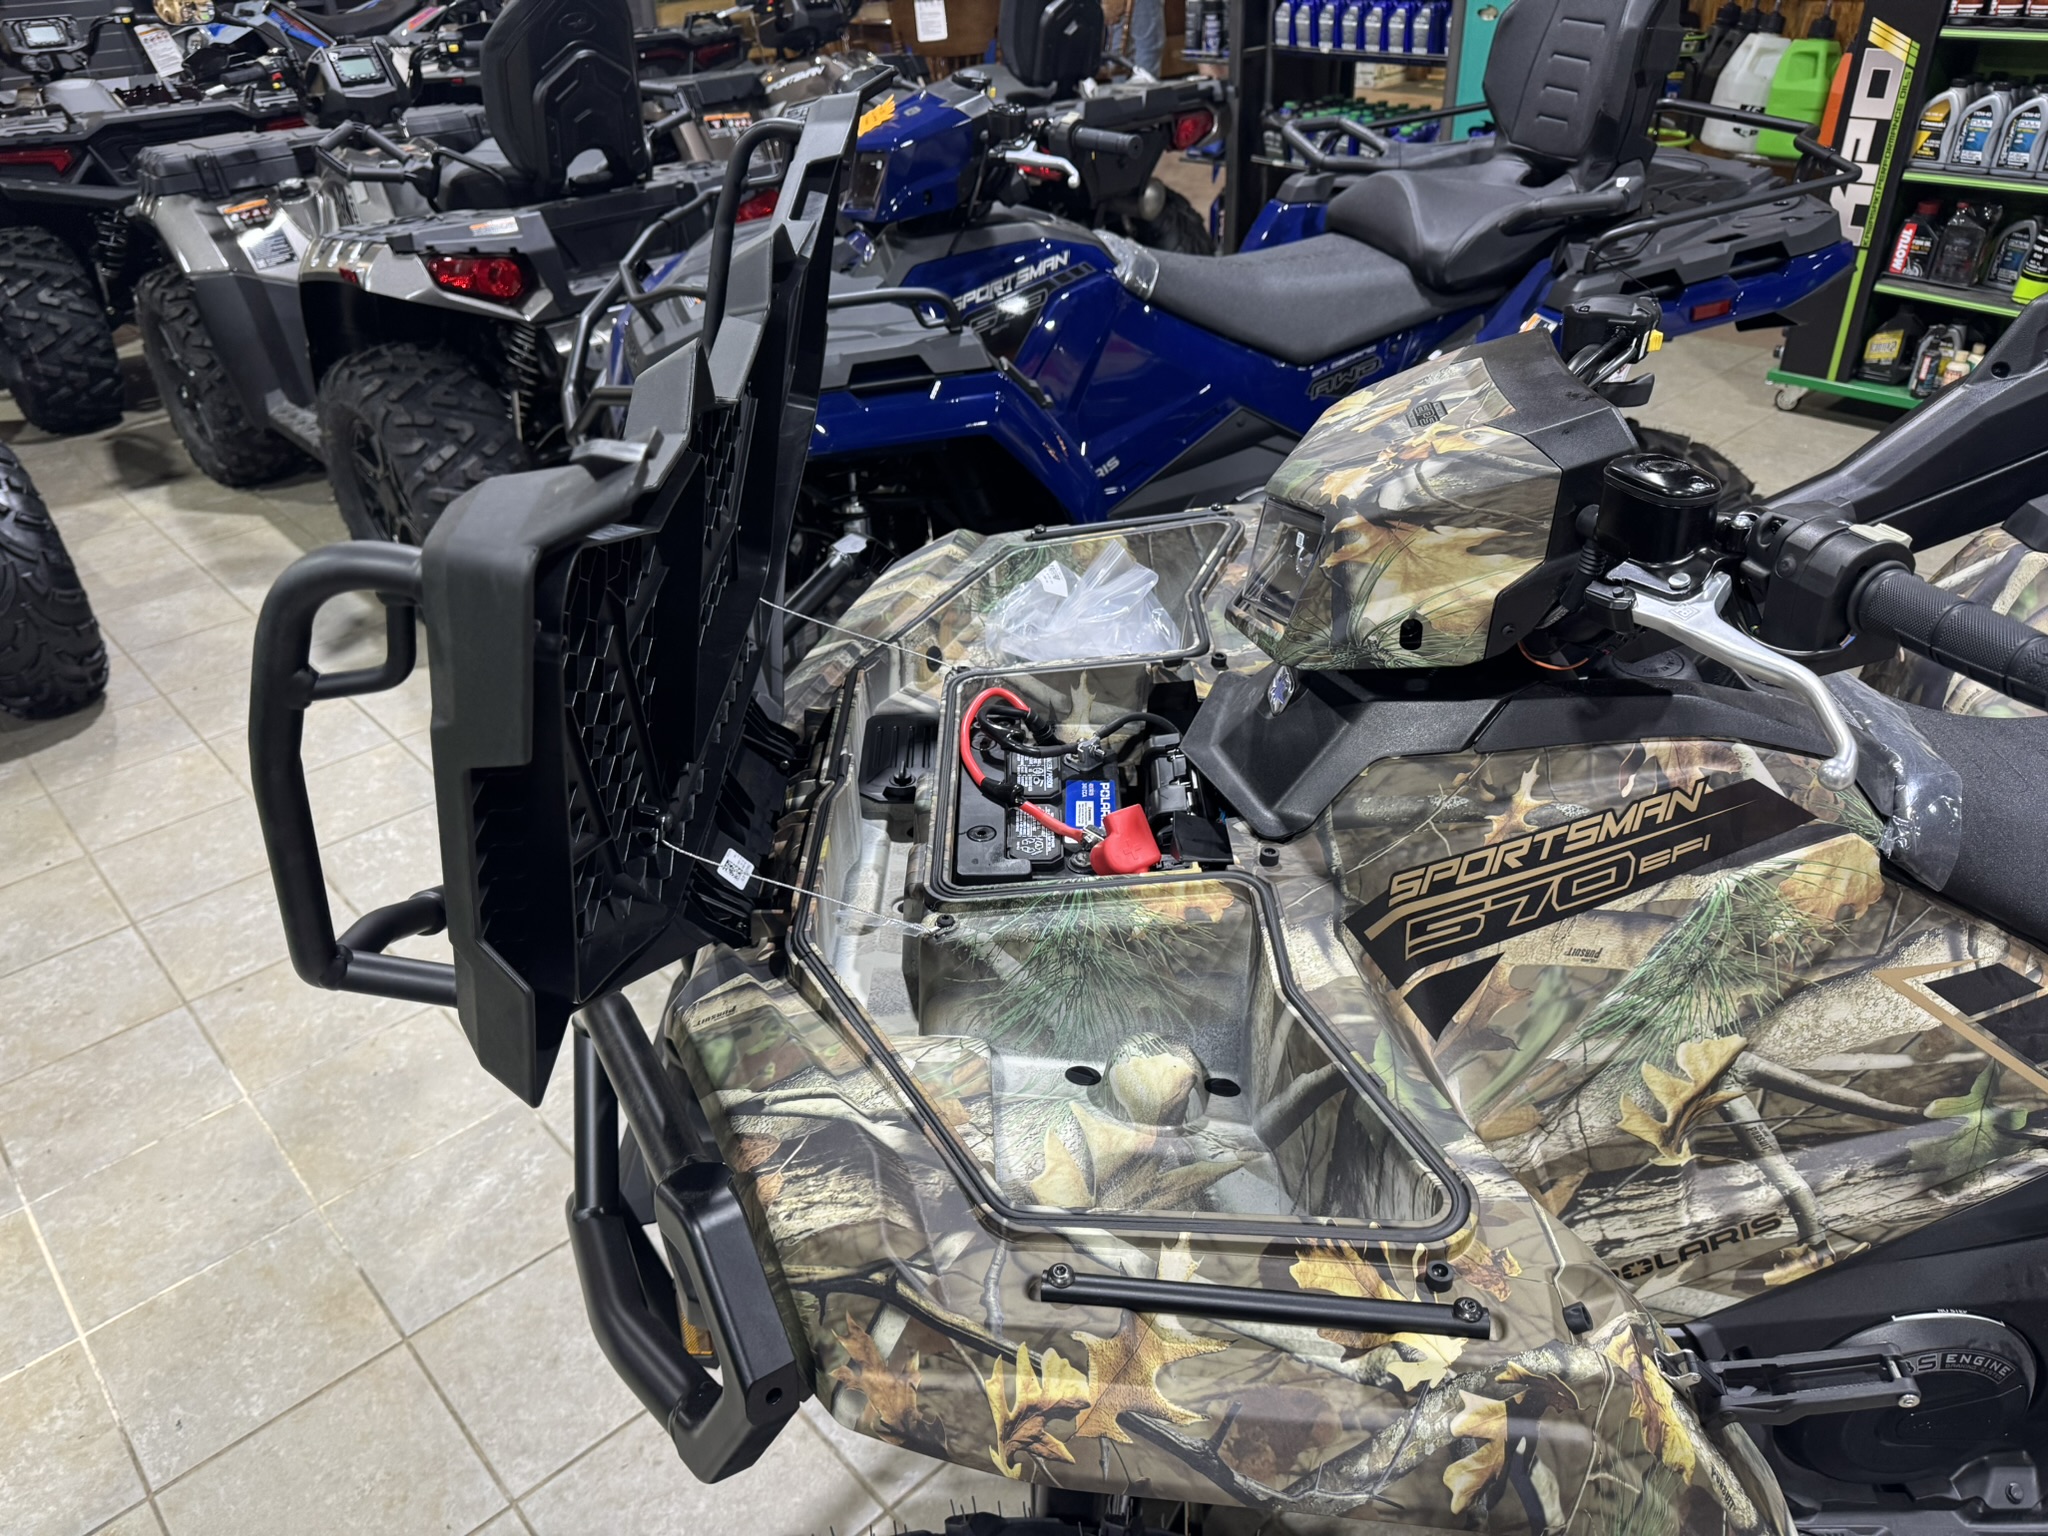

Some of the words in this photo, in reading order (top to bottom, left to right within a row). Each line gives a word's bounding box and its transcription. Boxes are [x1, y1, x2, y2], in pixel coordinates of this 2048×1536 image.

[1862, 194, 1883, 247] KAWASAKI
[1877, 101, 1904, 192] PERFORMANCE
[1899, 70, 1912, 99] OILS
[1892, 228, 1914, 270] MOTUL
[1308, 353, 1383, 401] AWD
[1388, 781, 1706, 908] SPORTSMAN
[1405, 850, 1637, 962] 570
[1639, 833, 1712, 876] EFI
[1564, 947, 1603, 958] PURSUIT
[1945, 1353, 2012, 1377] ENGINE
